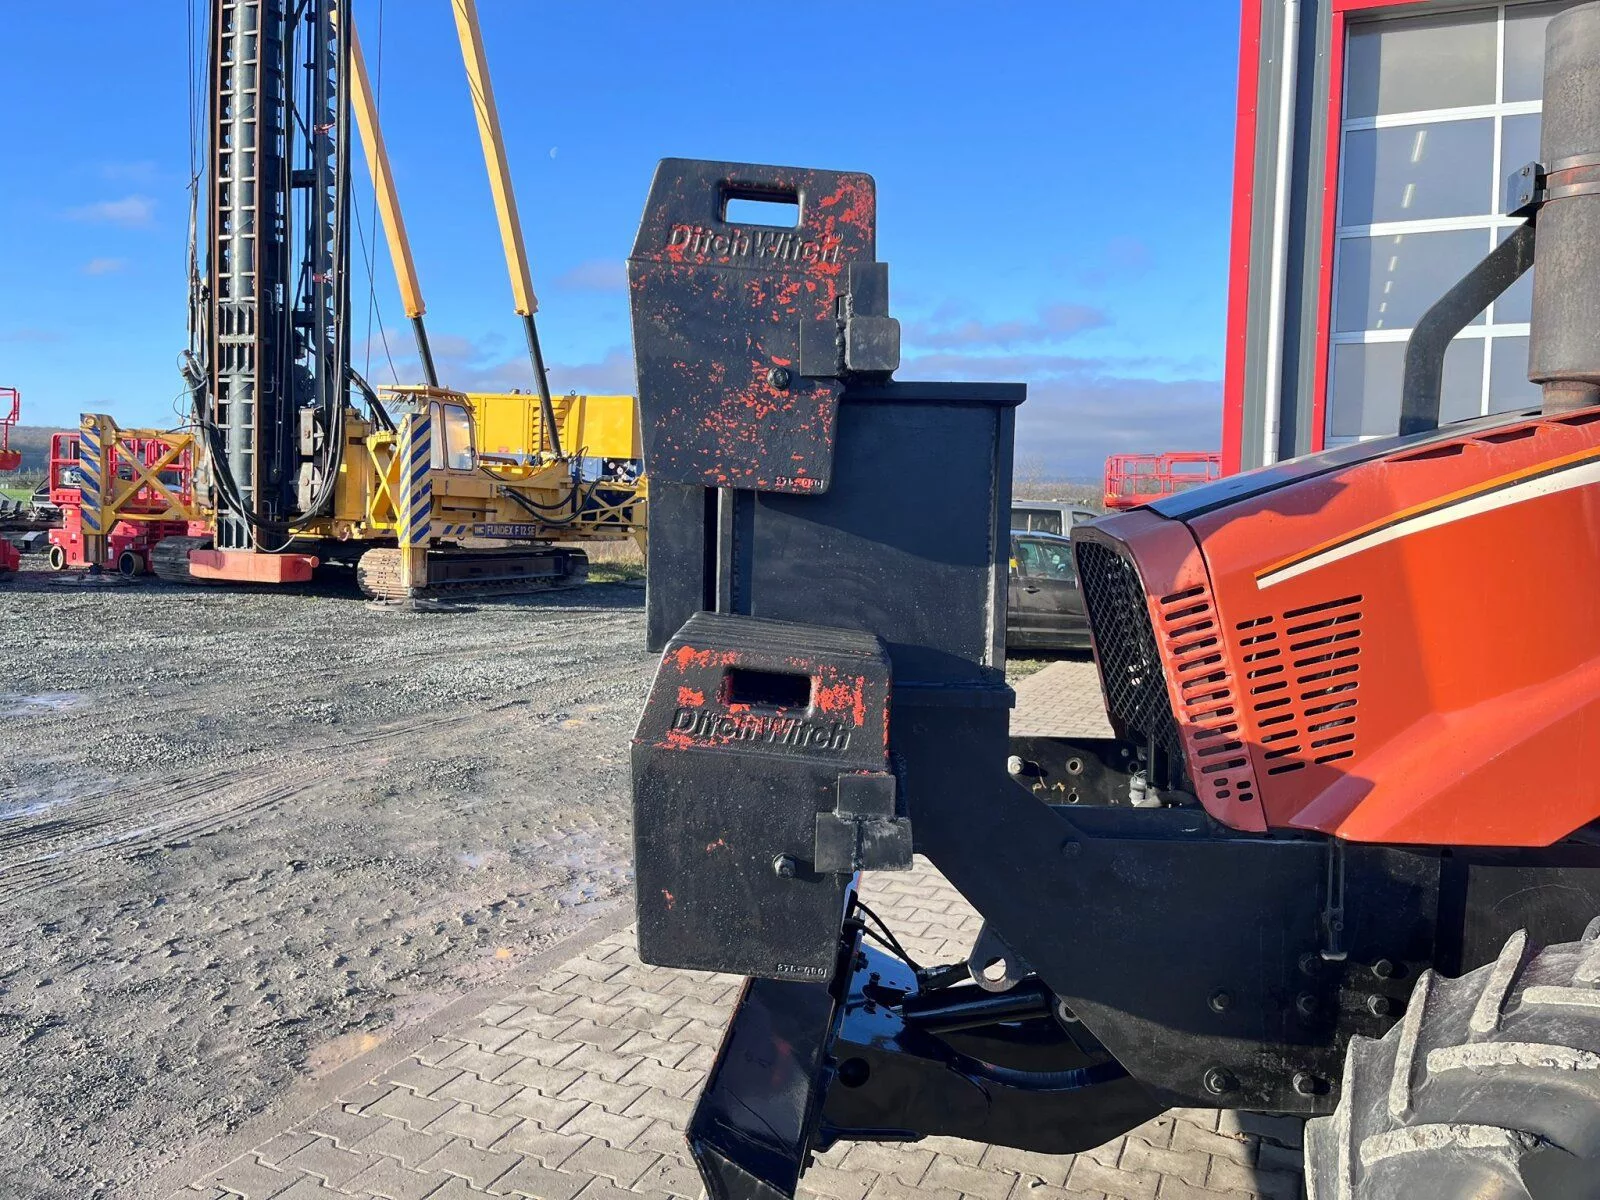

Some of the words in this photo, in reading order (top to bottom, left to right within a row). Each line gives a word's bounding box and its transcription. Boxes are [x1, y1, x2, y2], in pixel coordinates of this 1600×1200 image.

[668, 224, 749, 257] Ditch
[752, 230, 841, 263] Witch
[487, 525, 513, 535] FUNDEX
[514, 526, 519, 535] F
[520, 526, 526, 535] 12
[670, 707, 760, 742] Ditch
[761, 716, 852, 751] Witch
